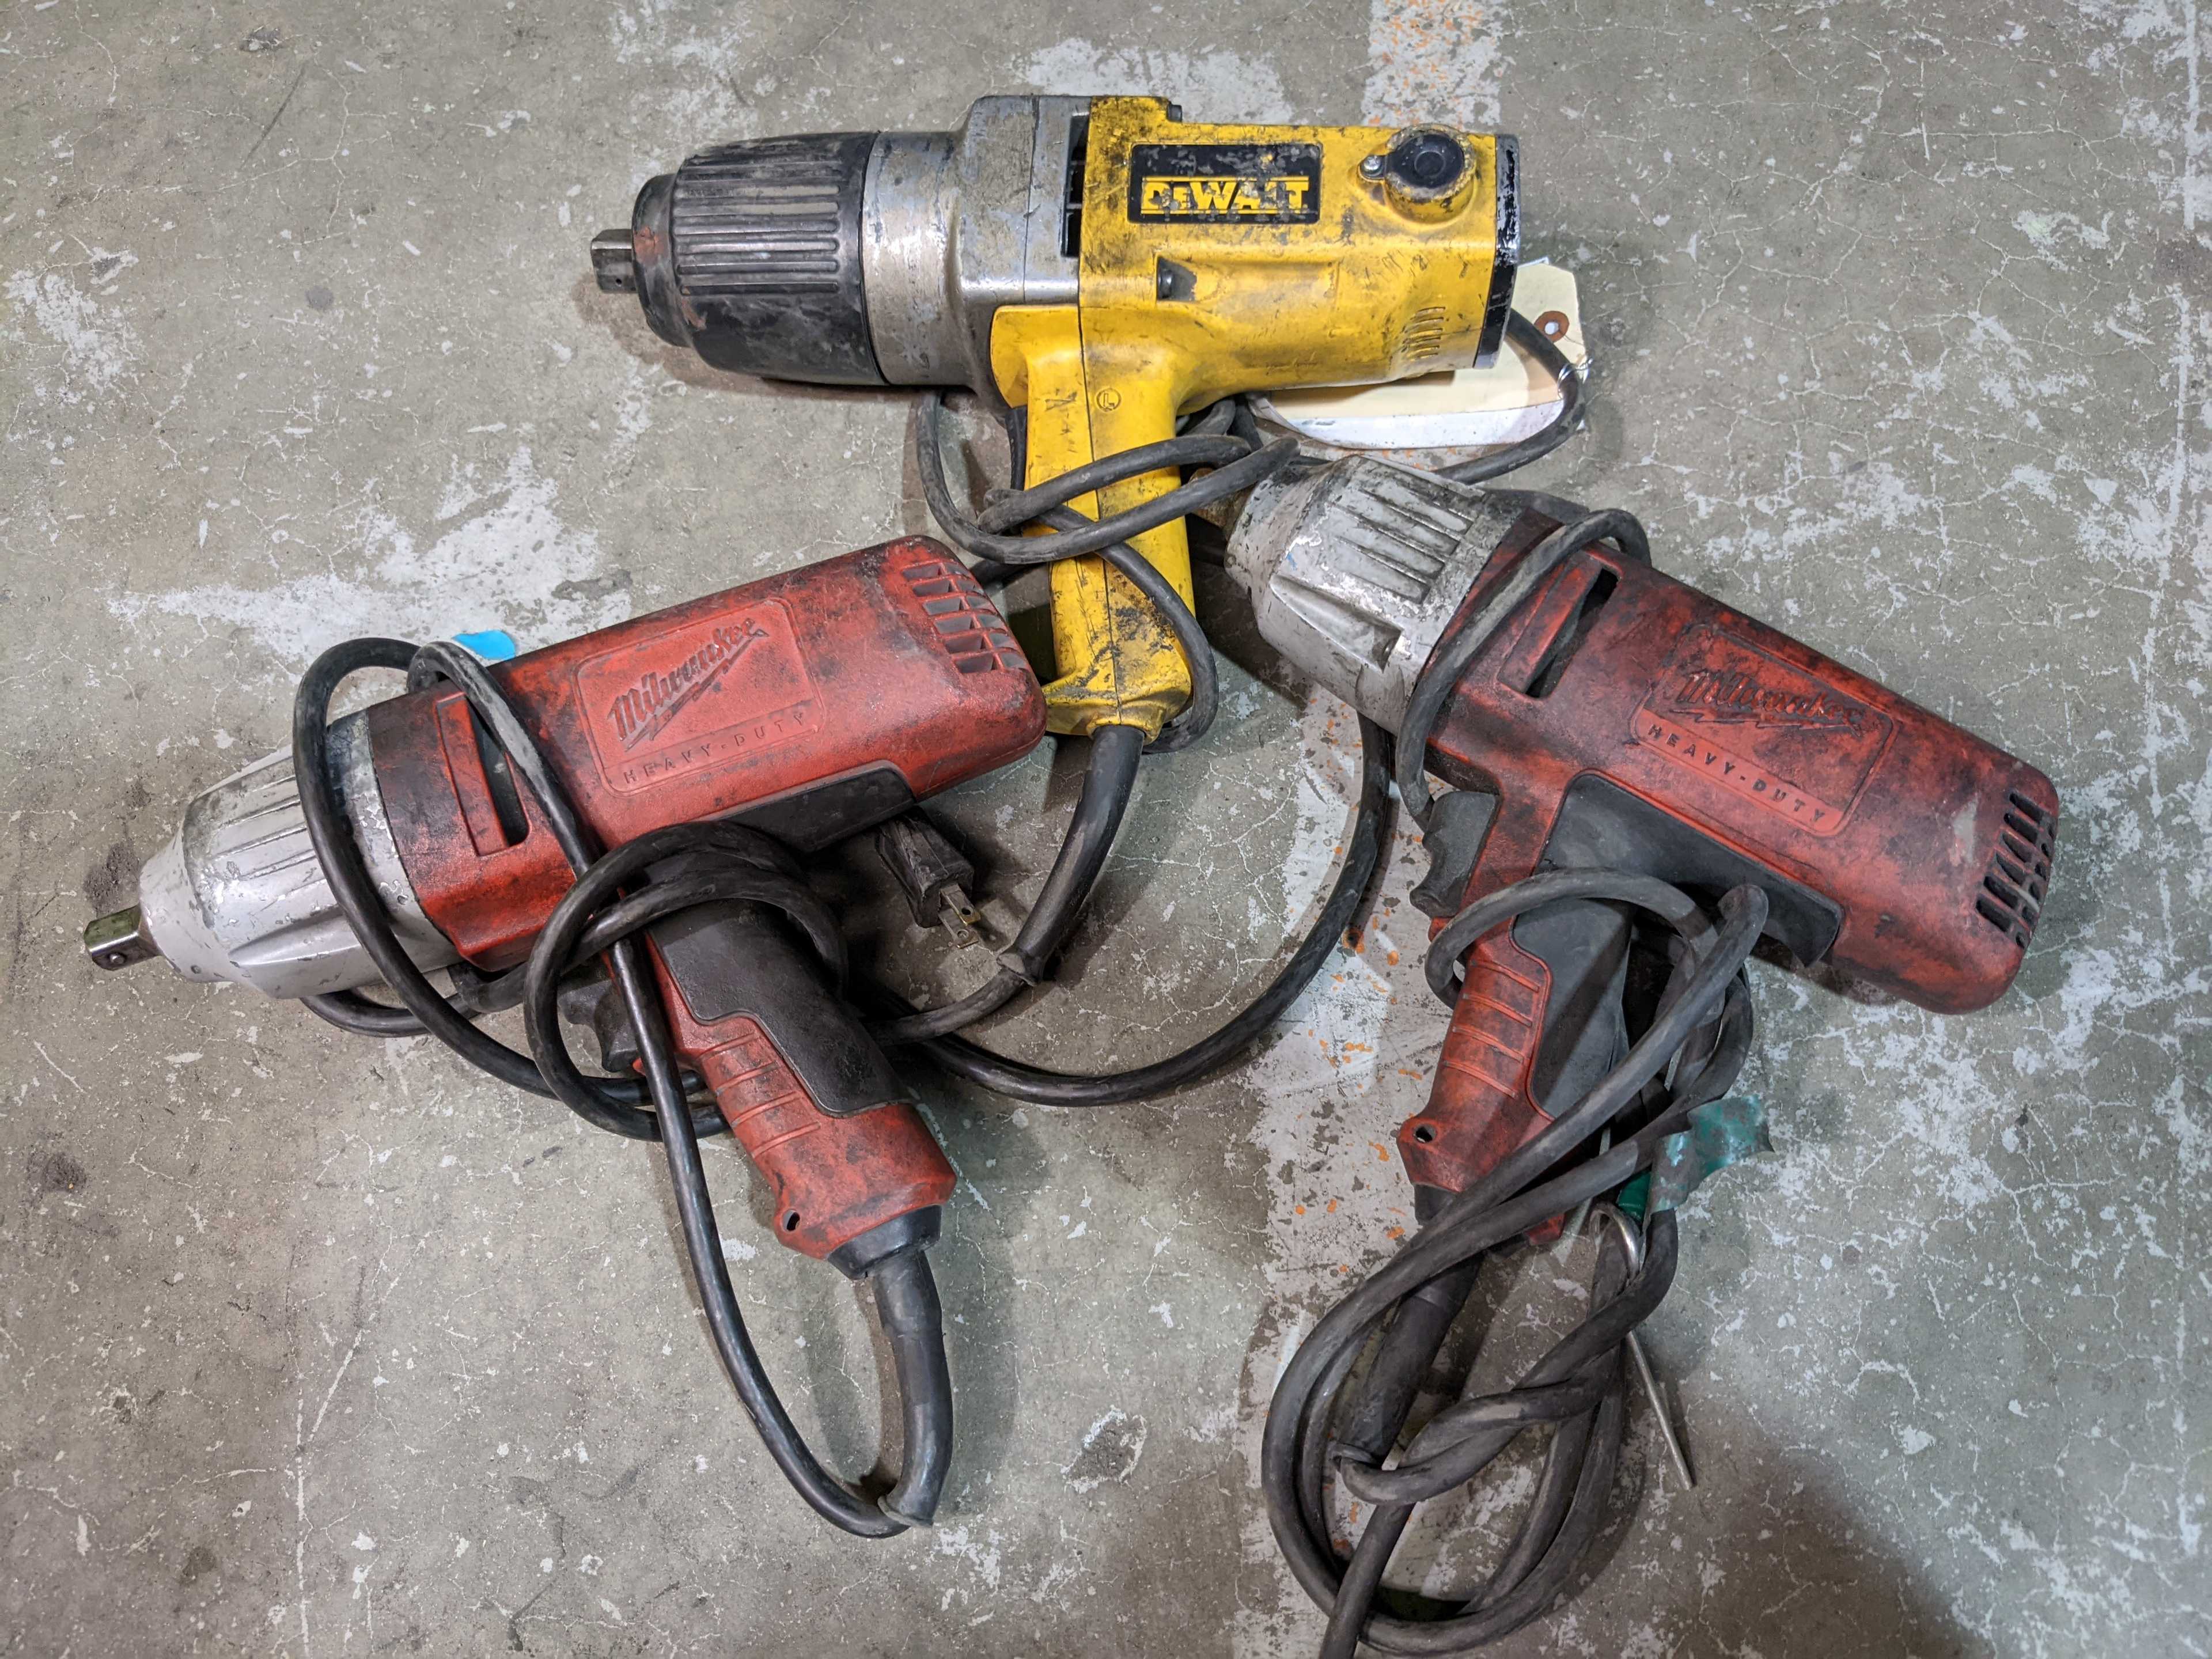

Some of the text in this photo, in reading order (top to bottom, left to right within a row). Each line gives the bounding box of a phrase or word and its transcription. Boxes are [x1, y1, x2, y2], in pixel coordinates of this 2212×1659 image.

[607, 617, 756, 742] Milwaukee
[623, 712, 806, 785] HEAVY-DUTY
[1647, 724, 1825, 823] HEAVY-DUTY
